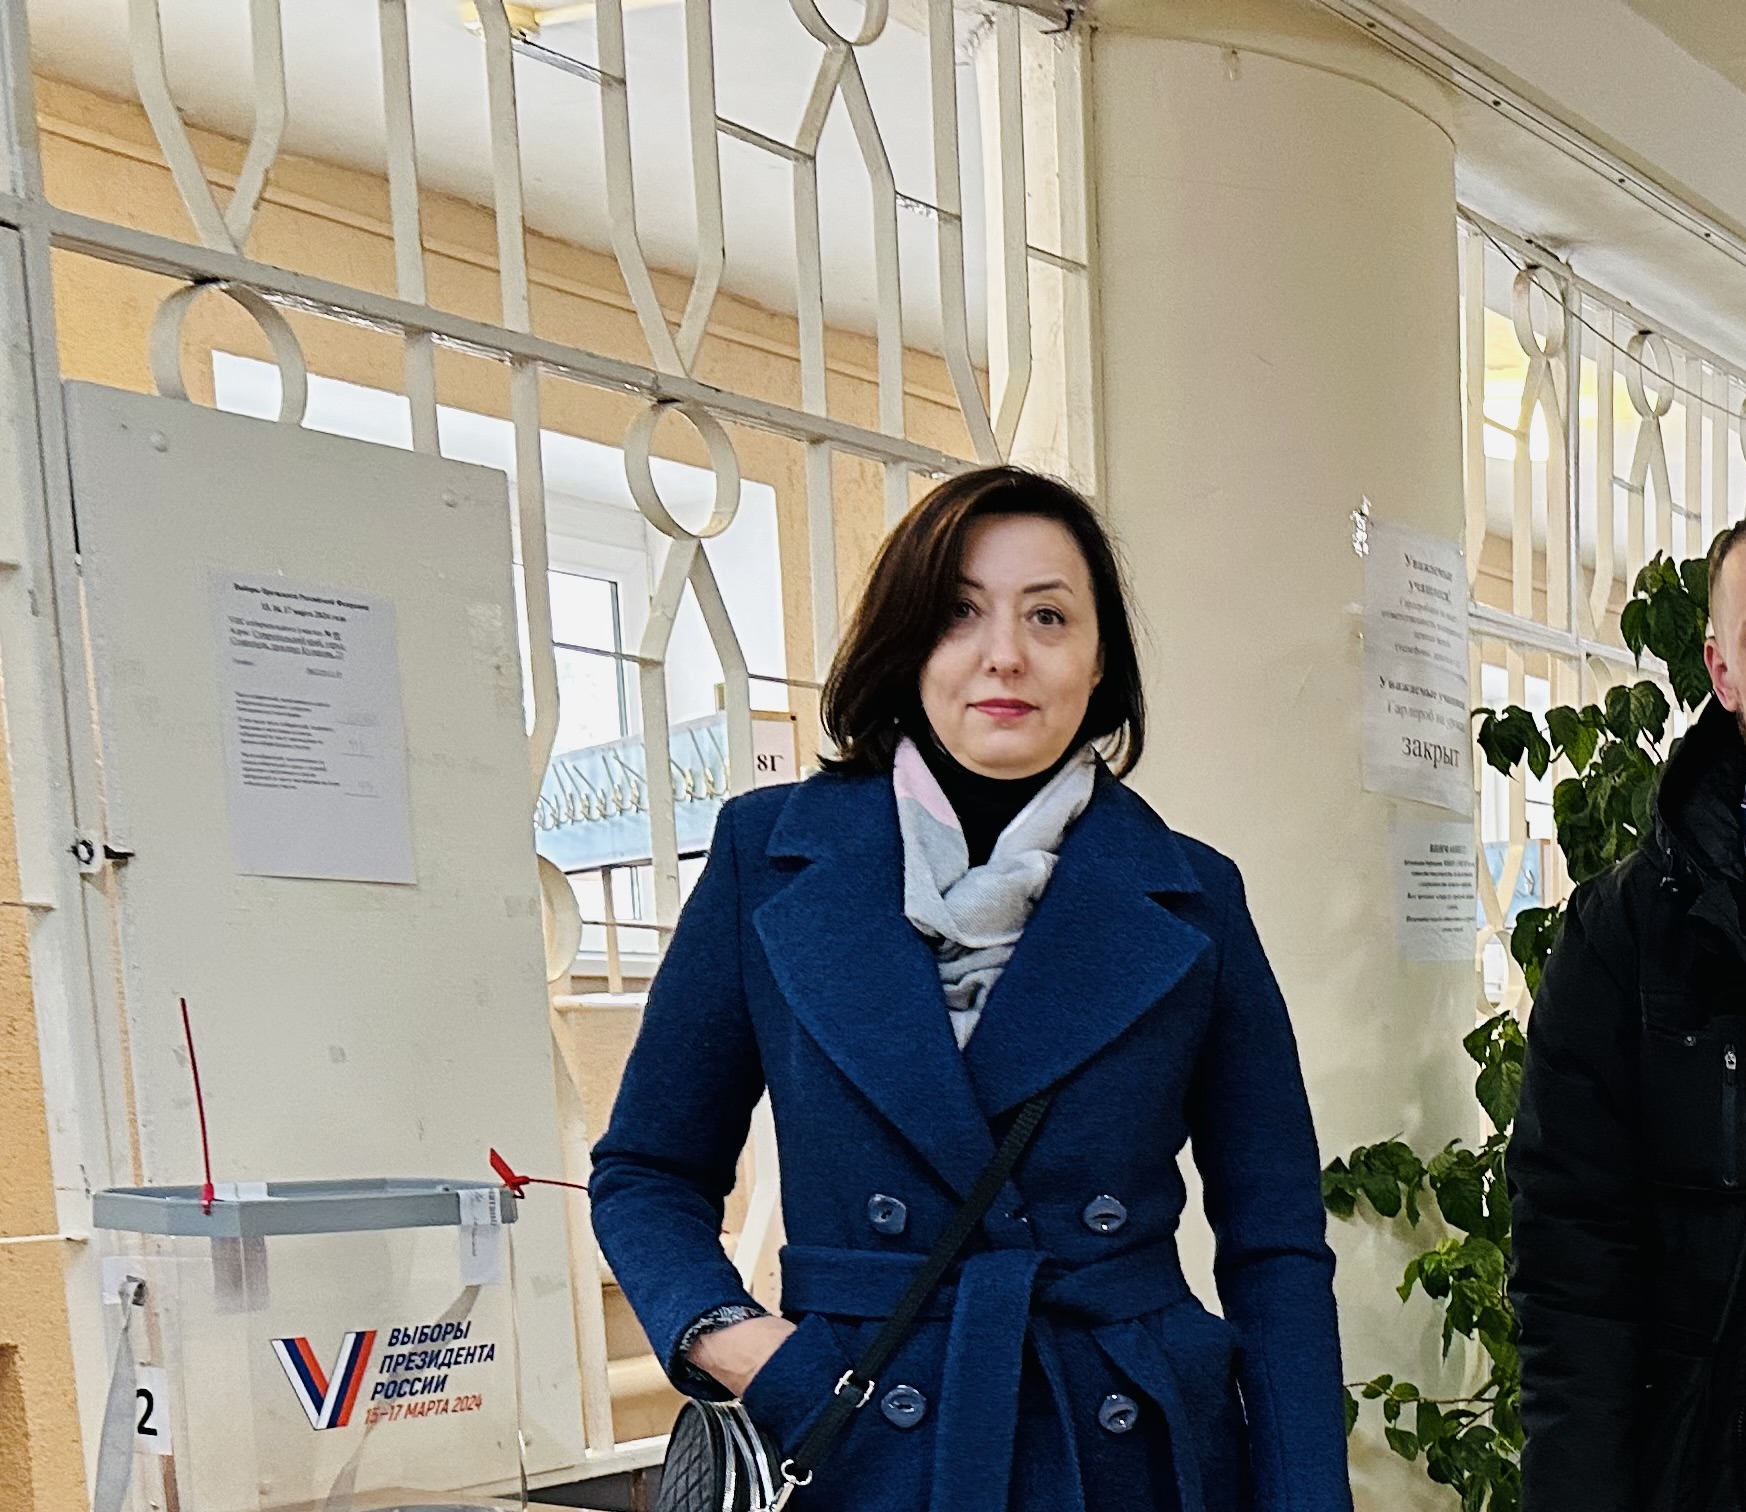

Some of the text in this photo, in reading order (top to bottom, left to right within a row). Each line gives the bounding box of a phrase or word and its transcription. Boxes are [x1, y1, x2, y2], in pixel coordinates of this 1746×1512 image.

[1402, 736, 1459, 769] закрыт
[388, 1321, 471, 1347] ВЫБОРЫ
[379, 1343, 495, 1374] ПРЕЗИДЕНТА
[371, 1374, 448, 1401] РОССИИ
[136, 1388, 158, 1436] 2
[404, 1399, 448, 1419] МАРТА
[451, 1394, 483, 1412] 2024
